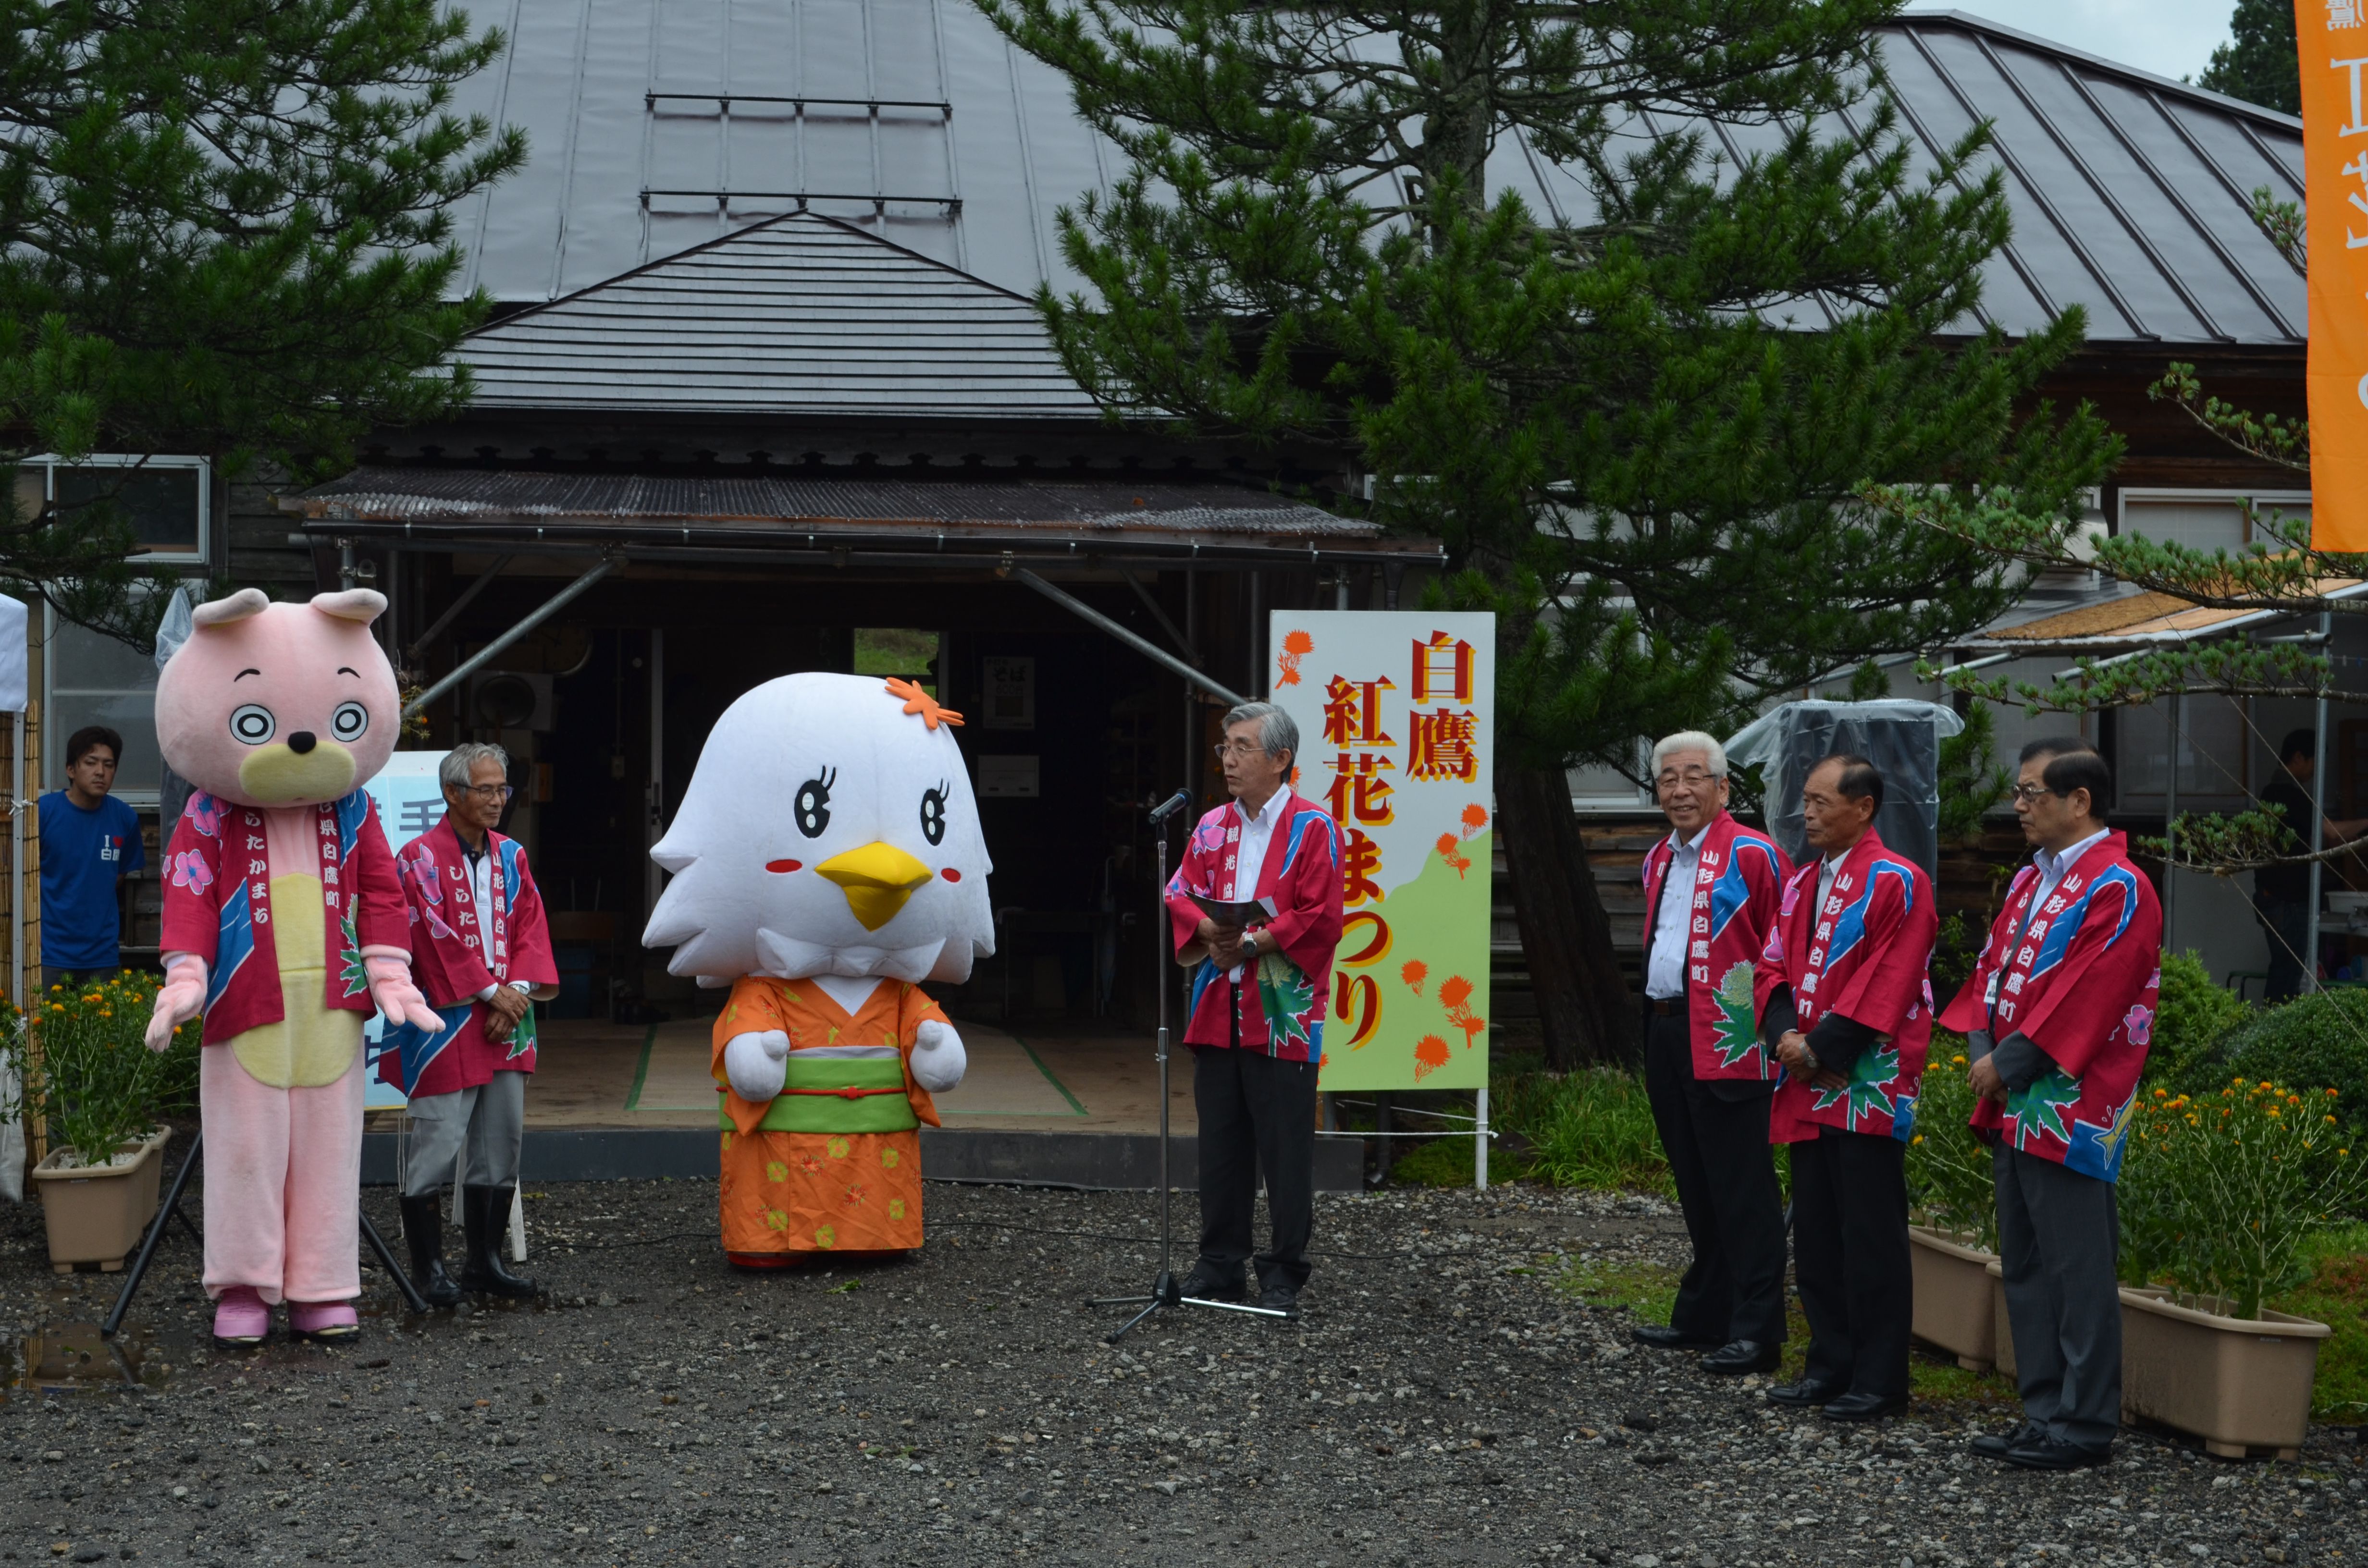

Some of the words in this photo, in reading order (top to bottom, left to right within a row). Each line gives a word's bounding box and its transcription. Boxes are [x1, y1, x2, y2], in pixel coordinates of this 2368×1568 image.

[1406, 630, 1480, 784] 白鷹
[105, 835, 110, 847] I
[245, 812, 268, 924] らたかまち
[1223, 825, 1239, 899] 観光協
[1322, 674, 1398, 1051] 紅花まつり
[449, 866, 481, 960] しらたか
[492, 852, 507, 980] 山形県白鷹町
[1691, 850, 1719, 983] 山形県白鷹町
[1798, 872, 1853, 1018] 山形県白鷹町
[1998, 873, 2083, 1023] 山形県白鷹町
